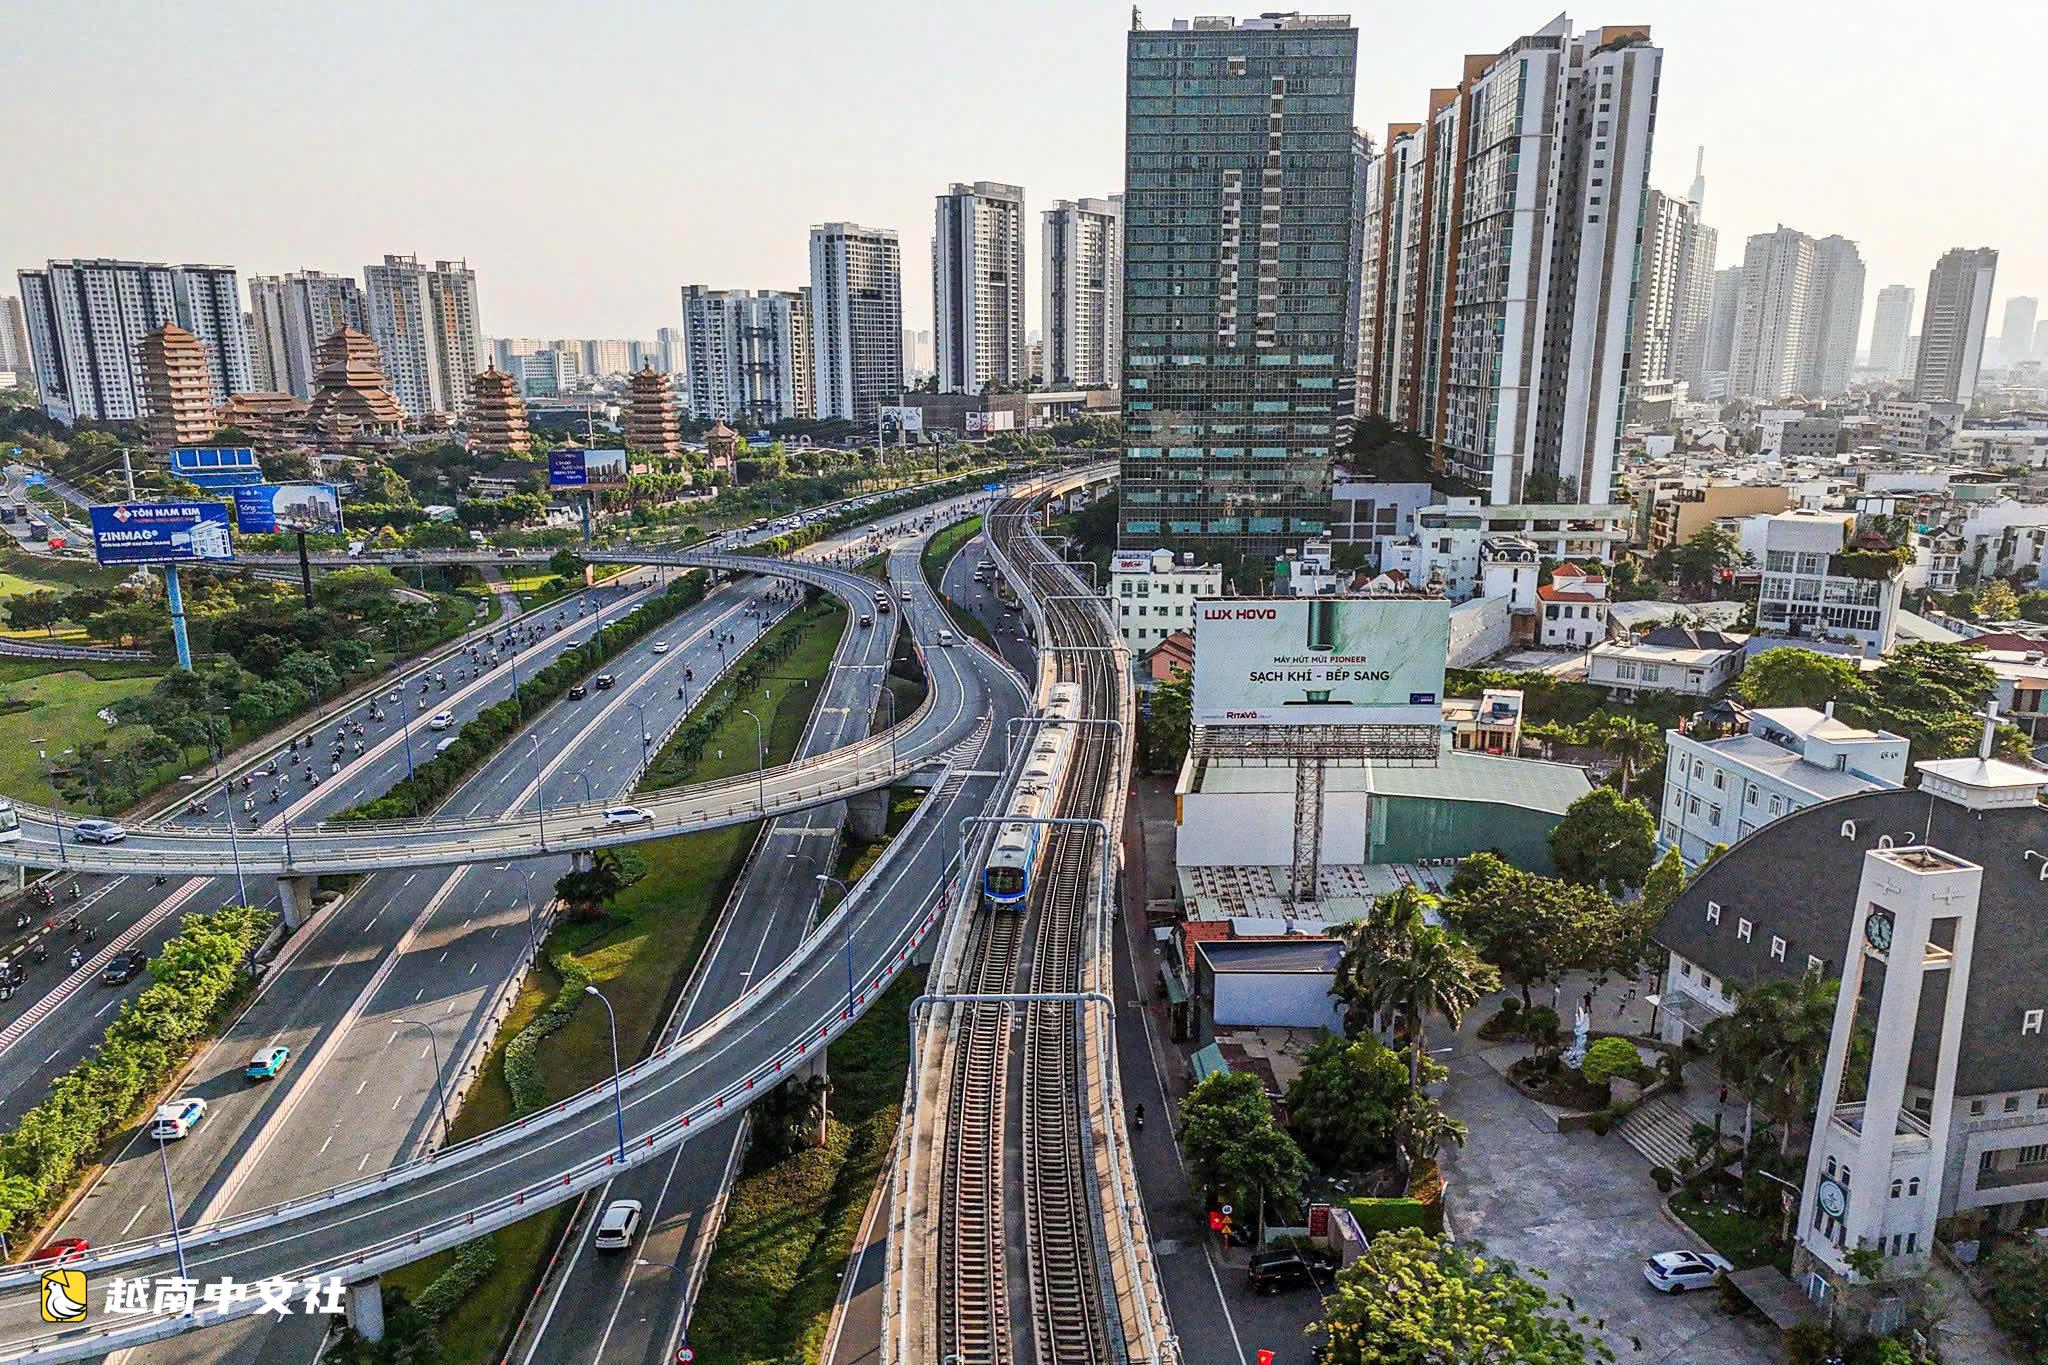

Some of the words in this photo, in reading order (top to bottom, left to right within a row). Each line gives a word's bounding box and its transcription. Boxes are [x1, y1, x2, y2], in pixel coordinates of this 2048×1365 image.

[131, 507, 153, 518] TÔN
[155, 508, 179, 517] NAM
[182, 507, 200, 516] KIM
[1204, 609, 1232, 620] LUX
[1236, 609, 1276, 620] HOVO
[1274, 655, 1290, 664] MÁY
[1292, 655, 1309, 664] HÚT
[1311, 655, 1327, 664] MÙI
[1250, 671, 1283, 684] SẠCH
[1288, 669, 1312, 682] KHÍ
[1326, 667, 1350, 681] BẾP
[1354, 671, 1390, 681] SANG
